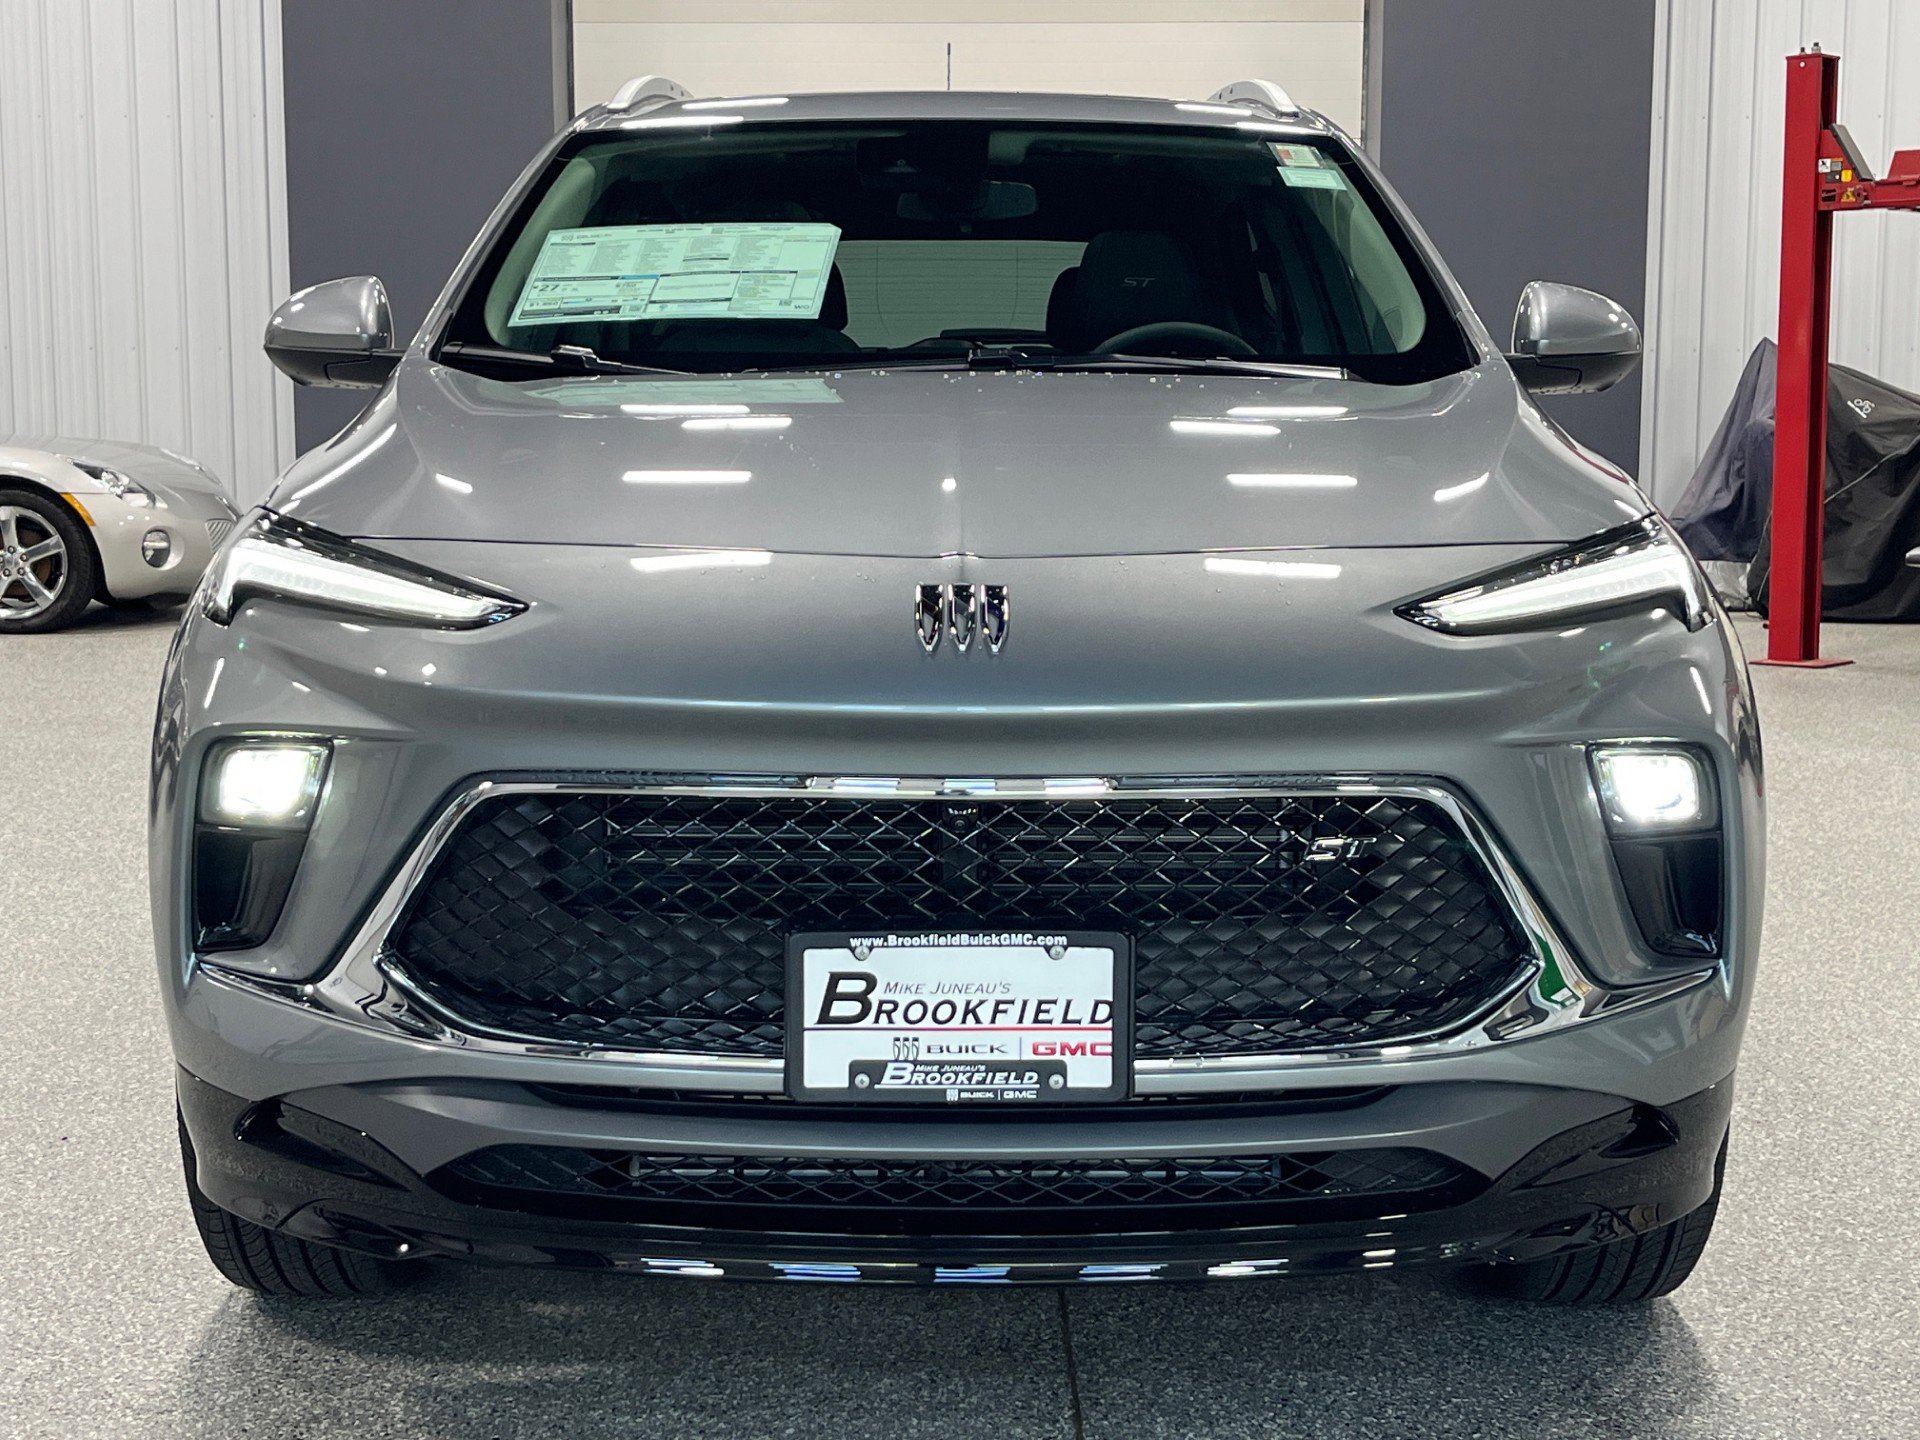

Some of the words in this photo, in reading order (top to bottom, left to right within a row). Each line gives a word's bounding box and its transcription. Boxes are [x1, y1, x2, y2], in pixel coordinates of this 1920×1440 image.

[1121, 276, 1156, 288] ST
[1305, 835, 1377, 861] ST
[850, 933, 1068, 947] www.BrookfieldBuickGMC.com
[814, 971, 1113, 1025] BROOKFIELD
[926, 1044, 1008, 1054] BUICK
[1032, 1041, 1113, 1056] GMC
[880, 1062, 1039, 1085] BROOKFIELD
[1003, 1090, 1037, 1099] GMC
